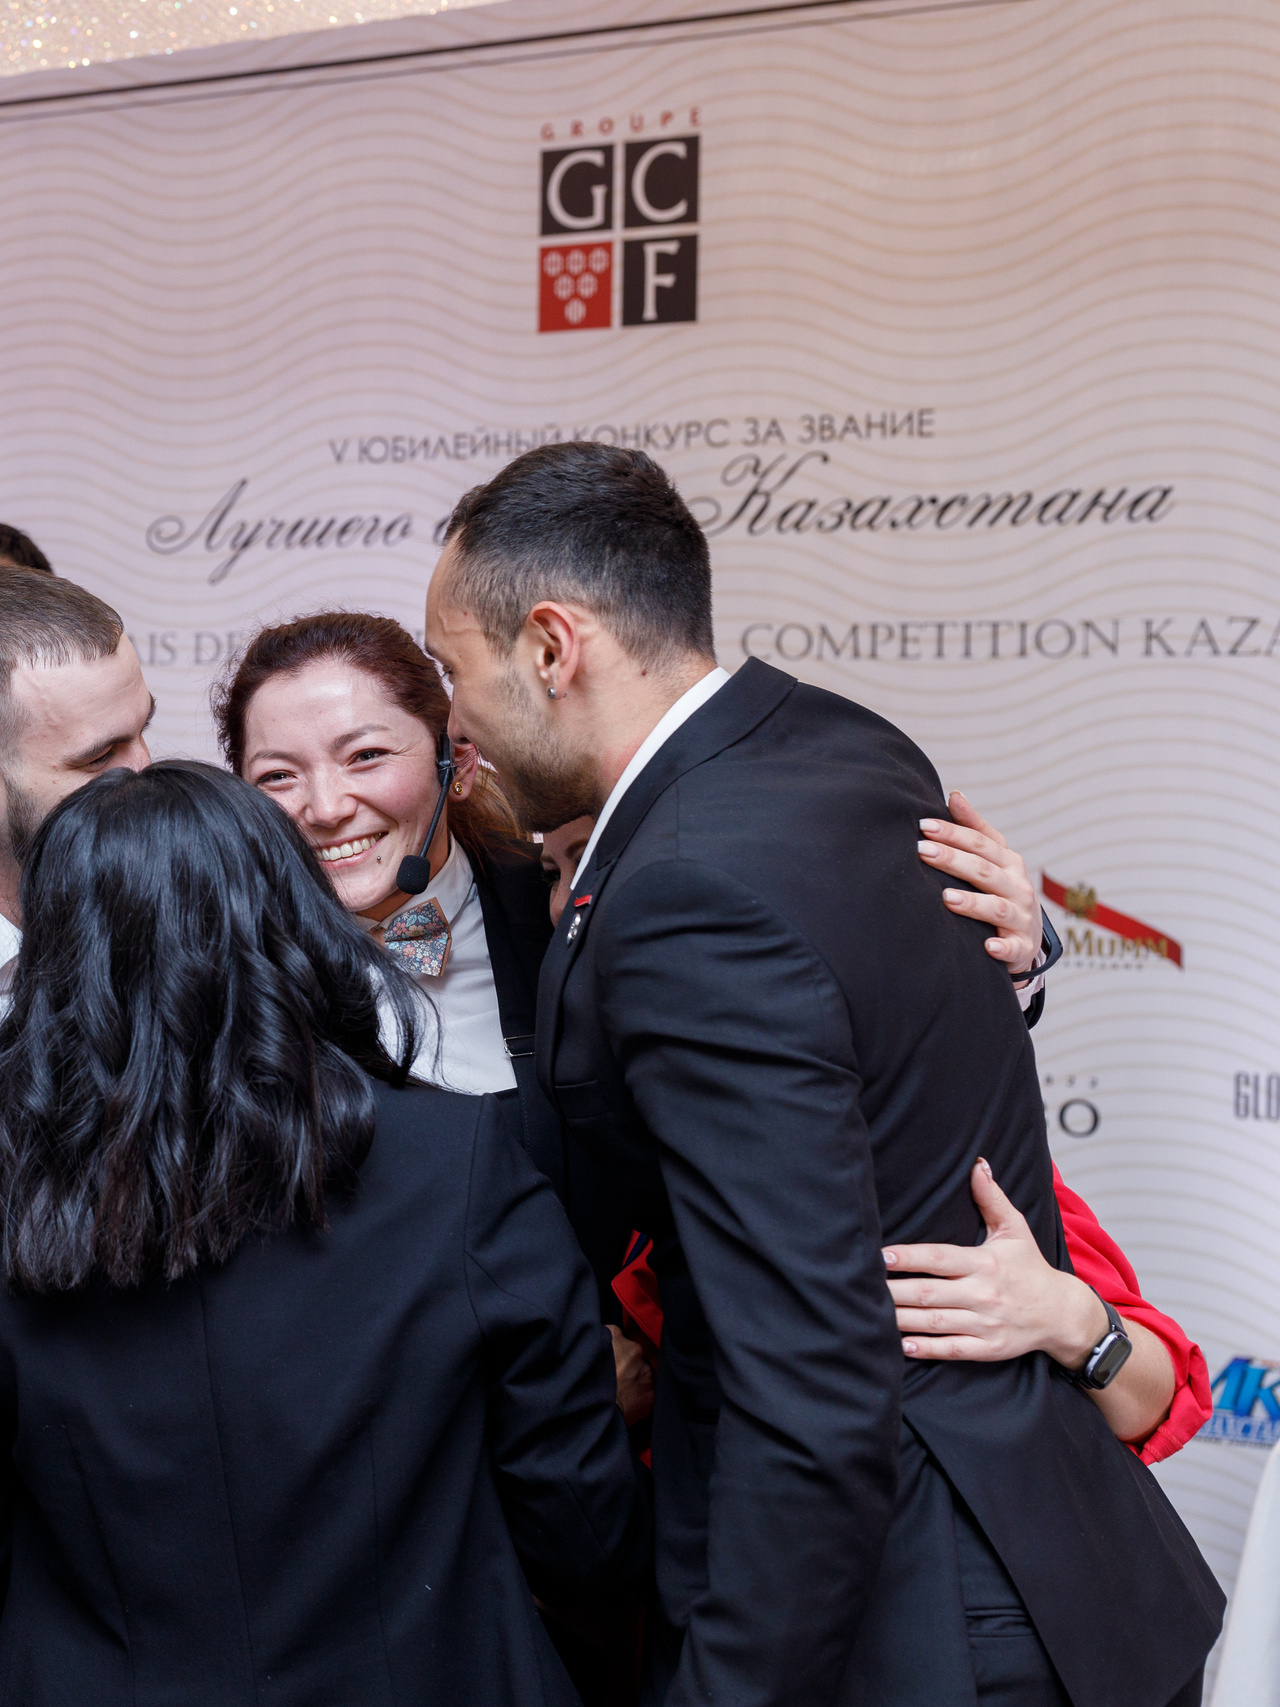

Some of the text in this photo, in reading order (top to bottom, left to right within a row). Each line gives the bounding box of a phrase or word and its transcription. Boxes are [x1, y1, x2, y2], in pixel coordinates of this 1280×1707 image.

[539, 107, 703, 142] GROUPE
[742, 417, 786, 447] ЗА
[797, 407, 936, 443] ЗВАНИЕ
[145, 476, 416, 587] Лучшего
[740, 617, 1122, 663] COMPETITION
